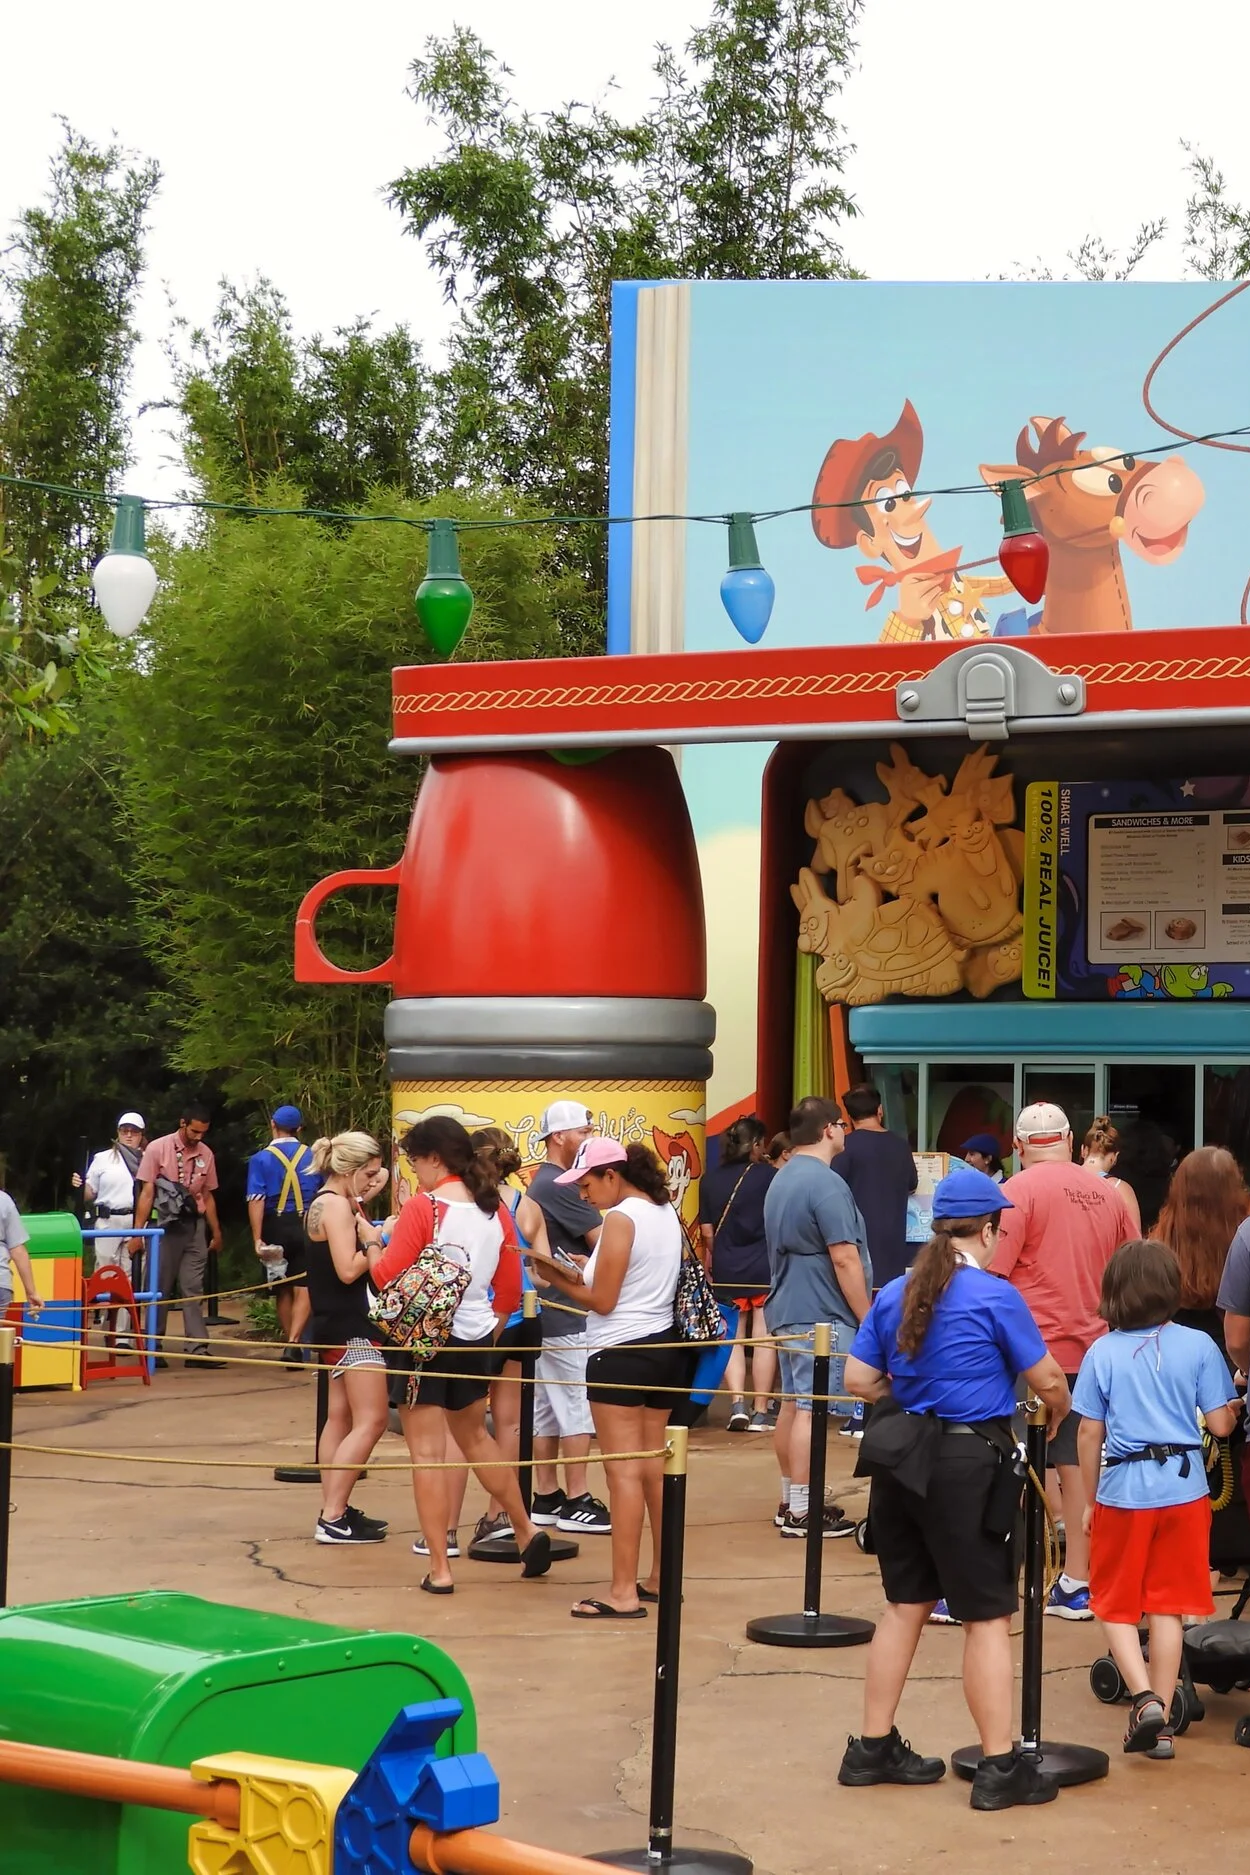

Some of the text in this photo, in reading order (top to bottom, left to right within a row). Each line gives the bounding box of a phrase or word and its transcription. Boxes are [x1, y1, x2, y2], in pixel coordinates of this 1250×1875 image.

[1060, 788, 1071, 857] SHAKE WELL
[1111, 816, 1193, 827] SANDWICHES & MORE
[1232, 855, 1250, 864] KIDS
[1038, 789, 1053, 990] 100% REAL JUICE!
